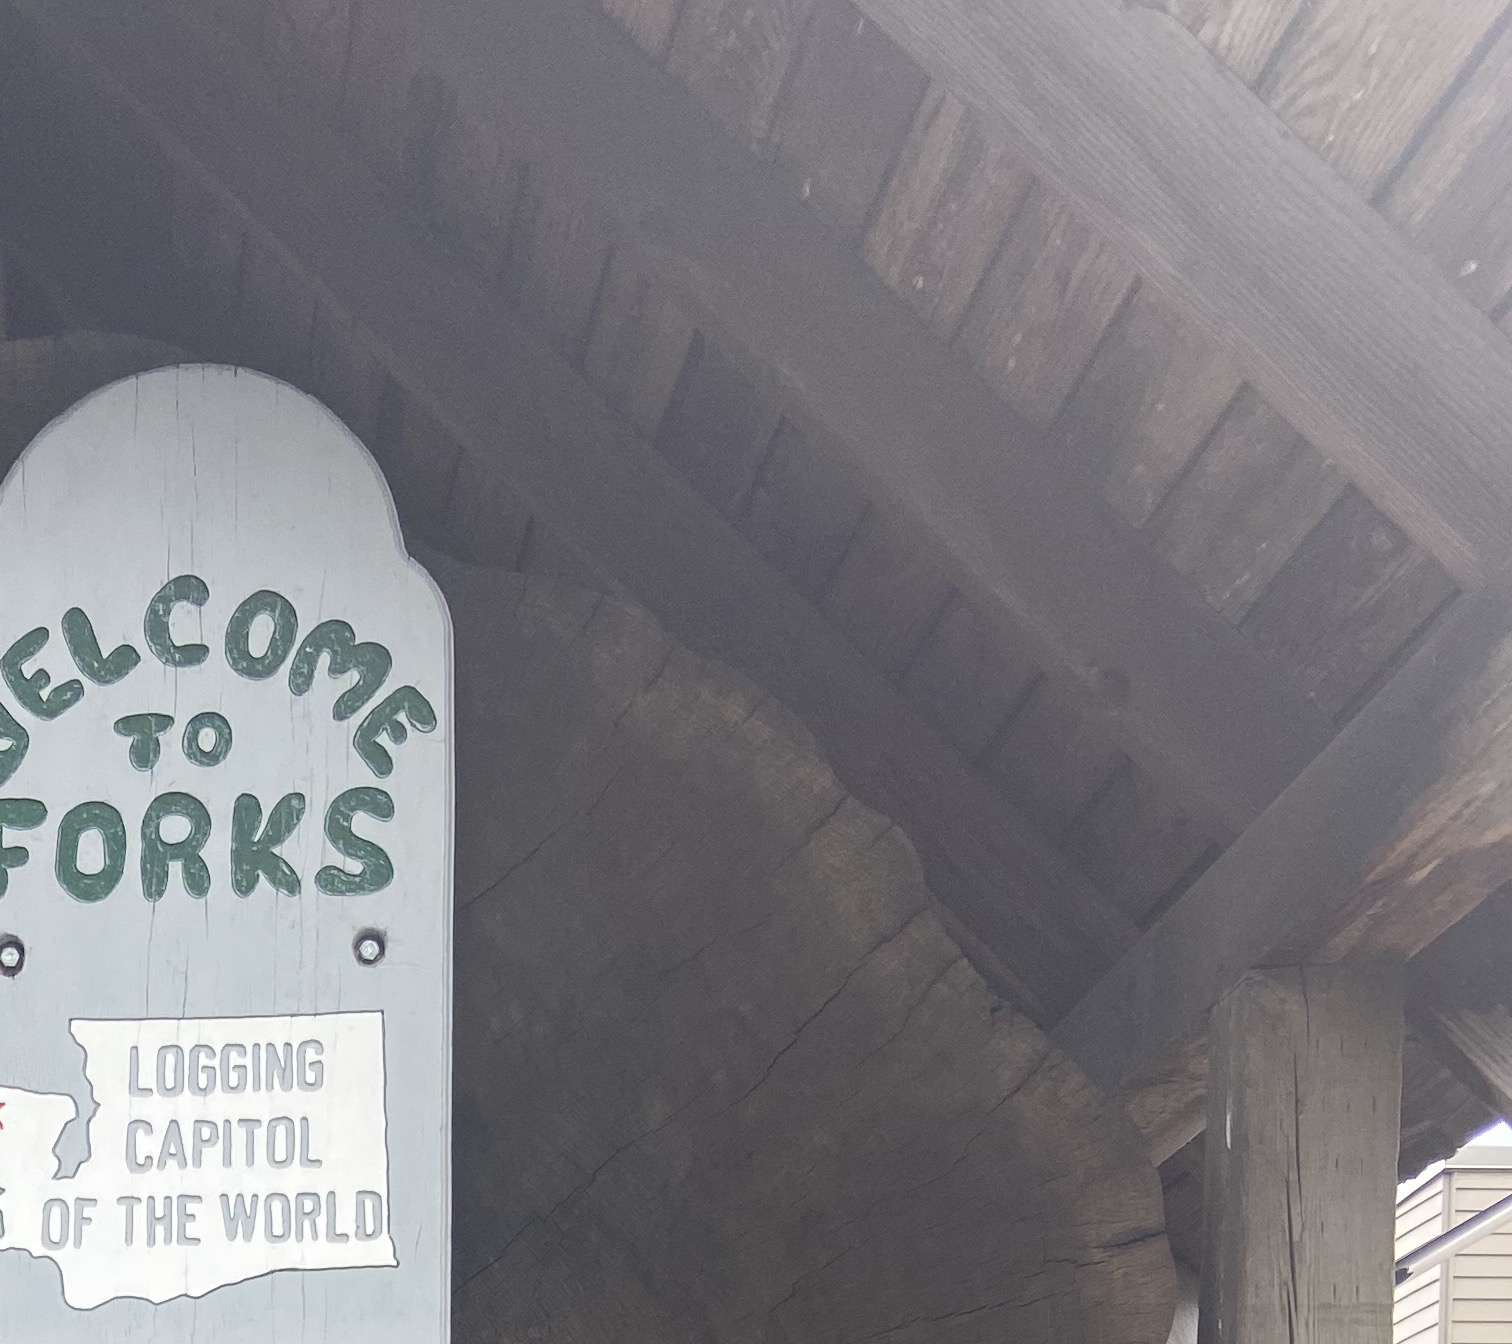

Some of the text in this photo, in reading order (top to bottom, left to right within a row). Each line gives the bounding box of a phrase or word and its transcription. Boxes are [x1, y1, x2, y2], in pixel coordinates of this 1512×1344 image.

[113, 711, 233, 771] TO
[128, 1039, 324, 1098] LOGGING
[125, 1115, 323, 1173] CAPITOL
[40, 1190, 385, 1249] OF THE WORLD
